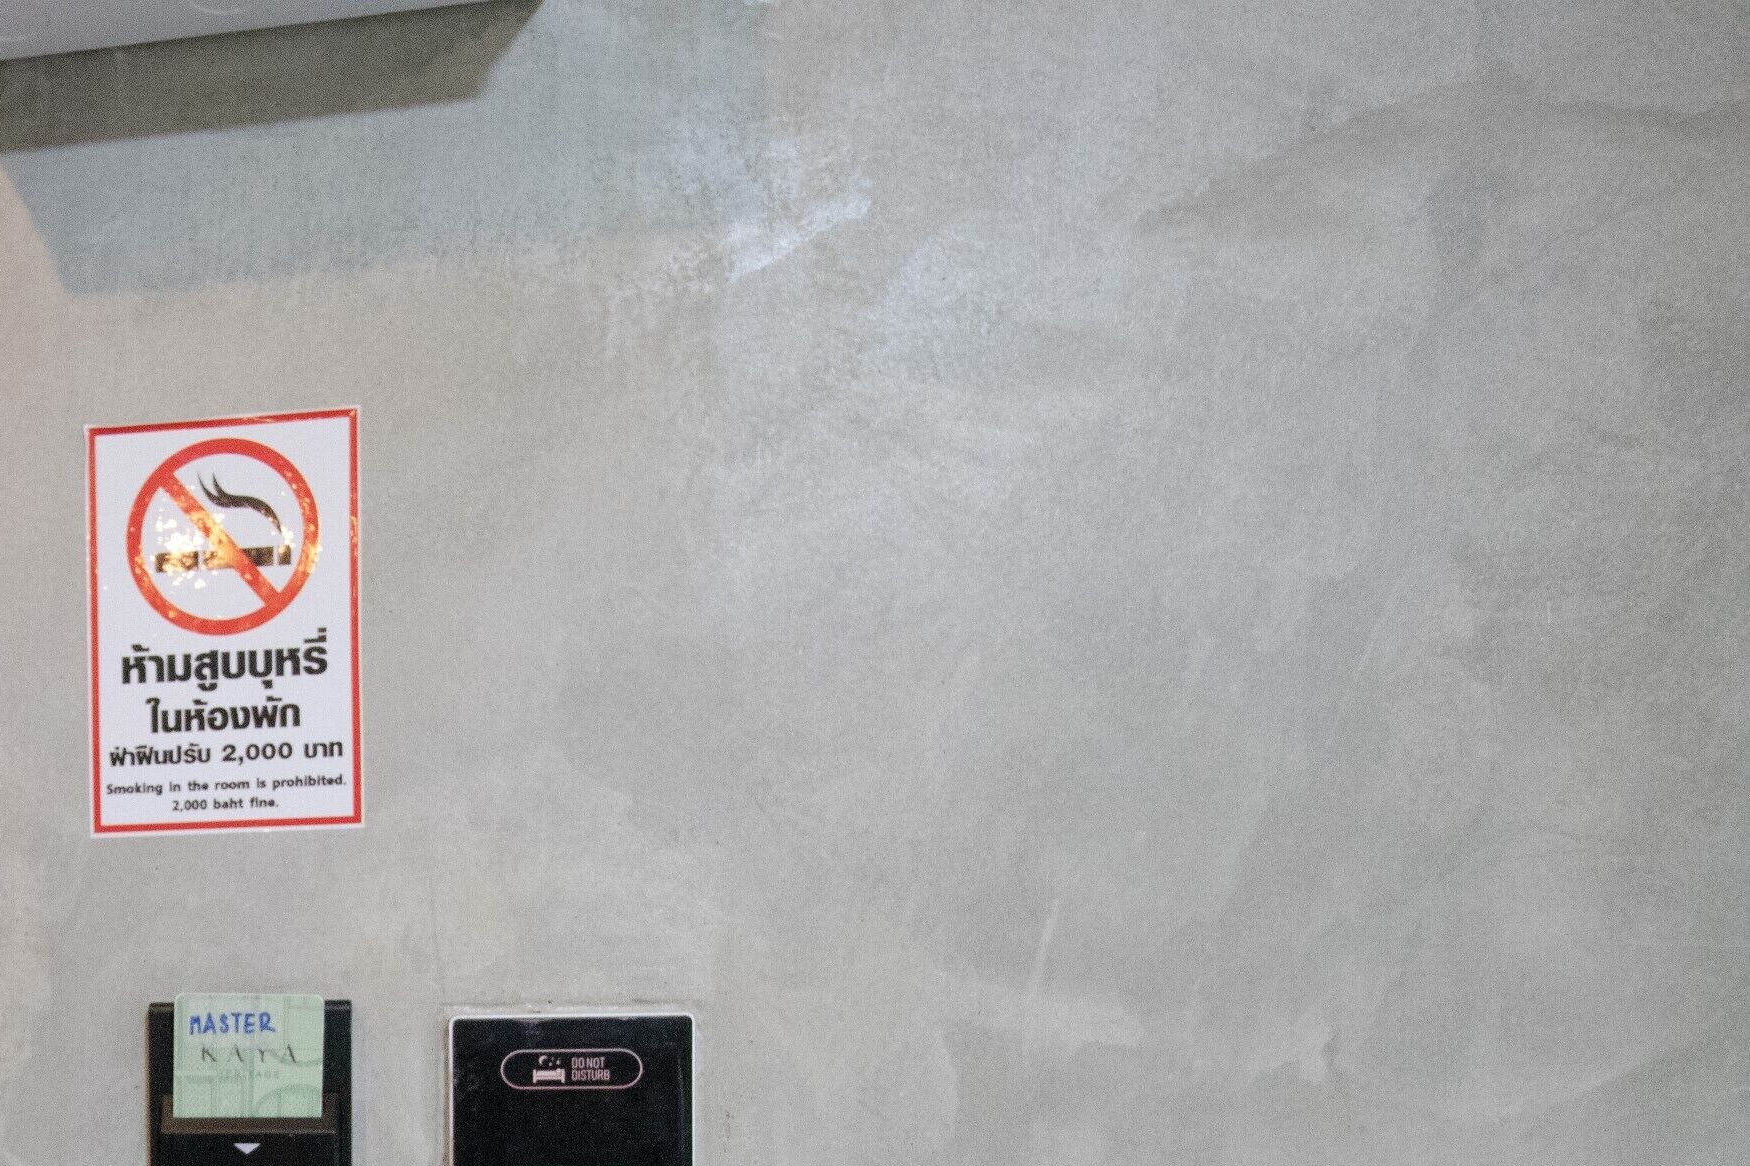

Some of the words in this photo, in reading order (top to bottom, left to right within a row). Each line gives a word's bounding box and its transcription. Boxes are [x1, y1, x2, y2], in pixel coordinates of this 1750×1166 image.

[121, 627, 328, 692] ห้ามสูบบุหรี่
[145, 695, 301, 733] ในห้องพัก
[222, 742, 293, 765] 2,000
[303, 740, 344, 758] บาท
[106, 783, 164, 796] Smoking
[169, 782, 181, 793] in
[187, 780, 209, 791] the
[214, 779, 250, 790] room
[256, 778, 267, 788] is
[272, 773, 347, 790] prohibited.
[172, 800, 208, 812] 2,000
[213, 798, 244, 809] baht
[189, 1011, 276, 1036] MASTER
[571, 1057, 585, 1069] DO
[586, 1057, 605, 1069] NOT
[571, 1069, 611, 1081] DISTURB
